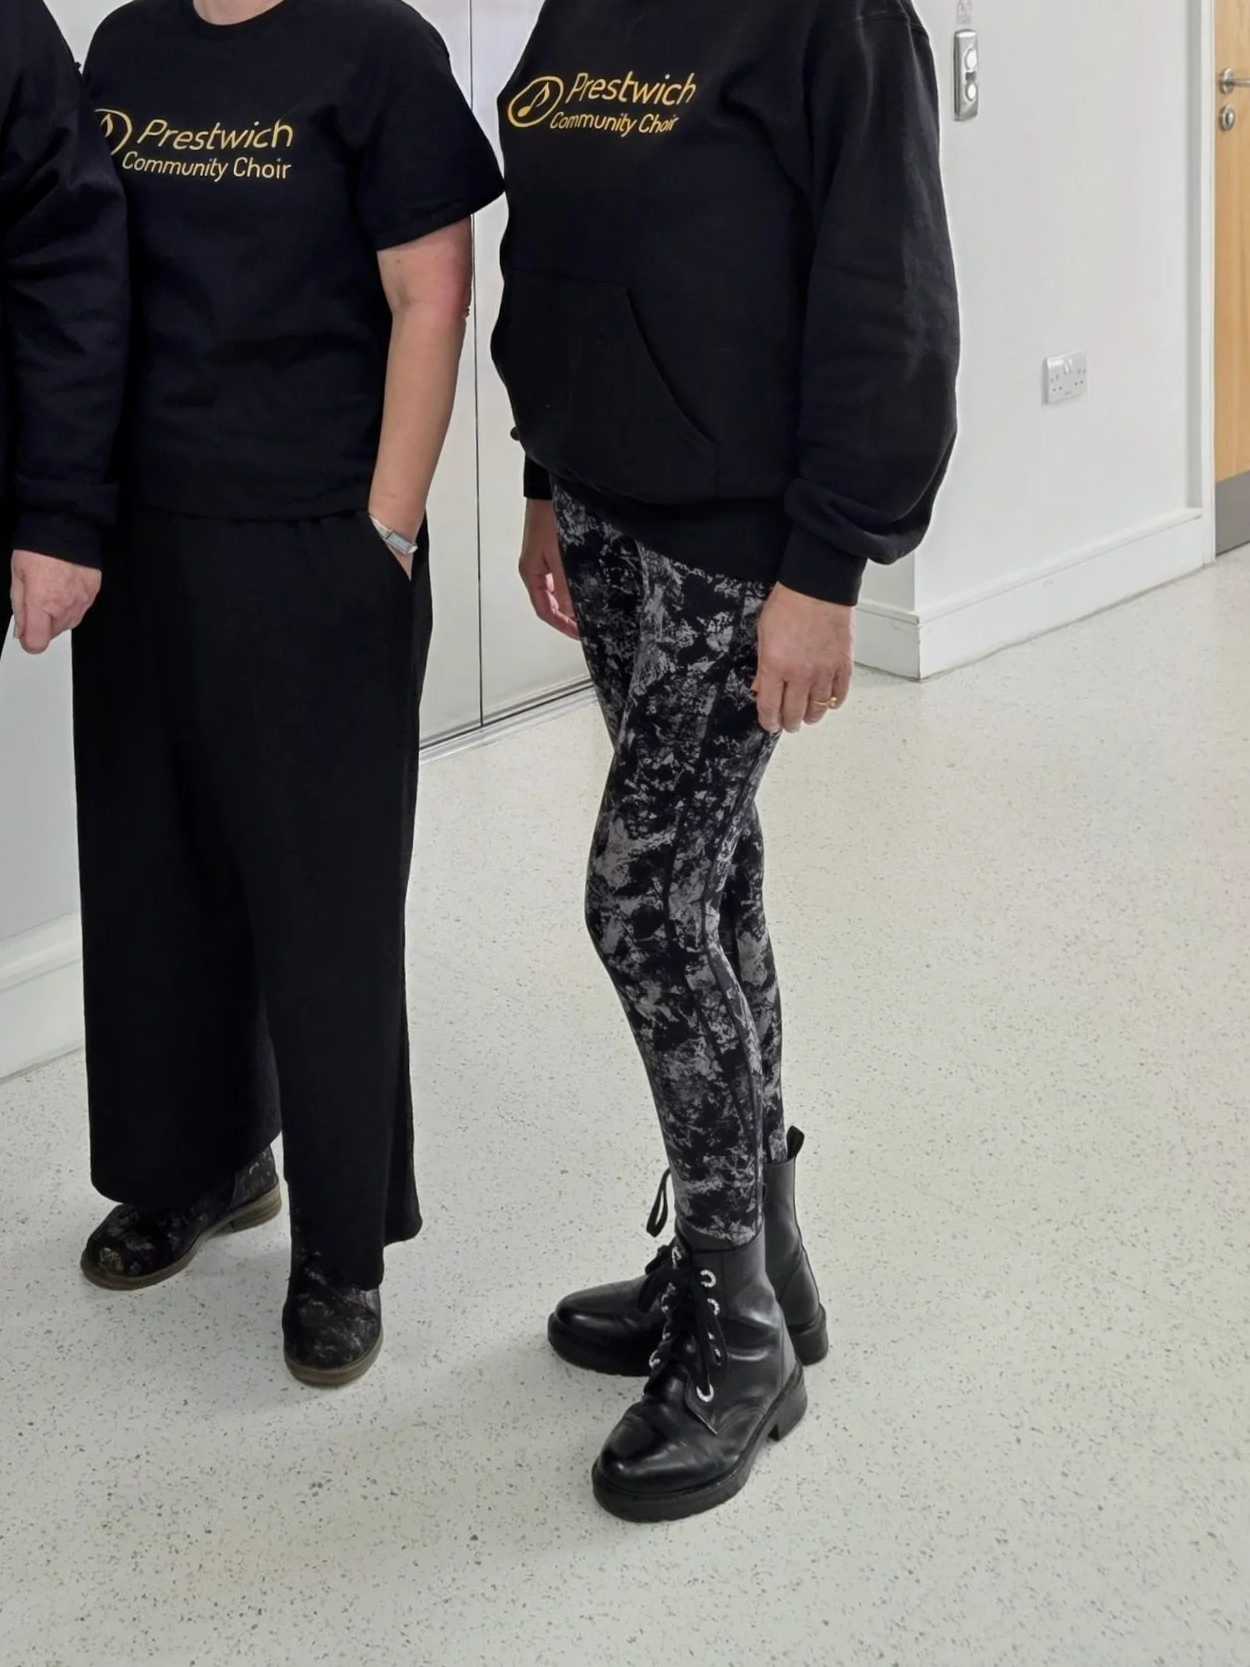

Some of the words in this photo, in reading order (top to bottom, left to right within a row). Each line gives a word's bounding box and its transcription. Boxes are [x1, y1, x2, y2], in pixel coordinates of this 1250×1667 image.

[565, 71, 697, 107] Prestwich
[137, 119, 294, 150] Prestwich
[550, 112, 637, 138] Community
[638, 114, 679, 134] Choir
[122, 150, 229, 182] Community
[233, 156, 292, 179] Choir
